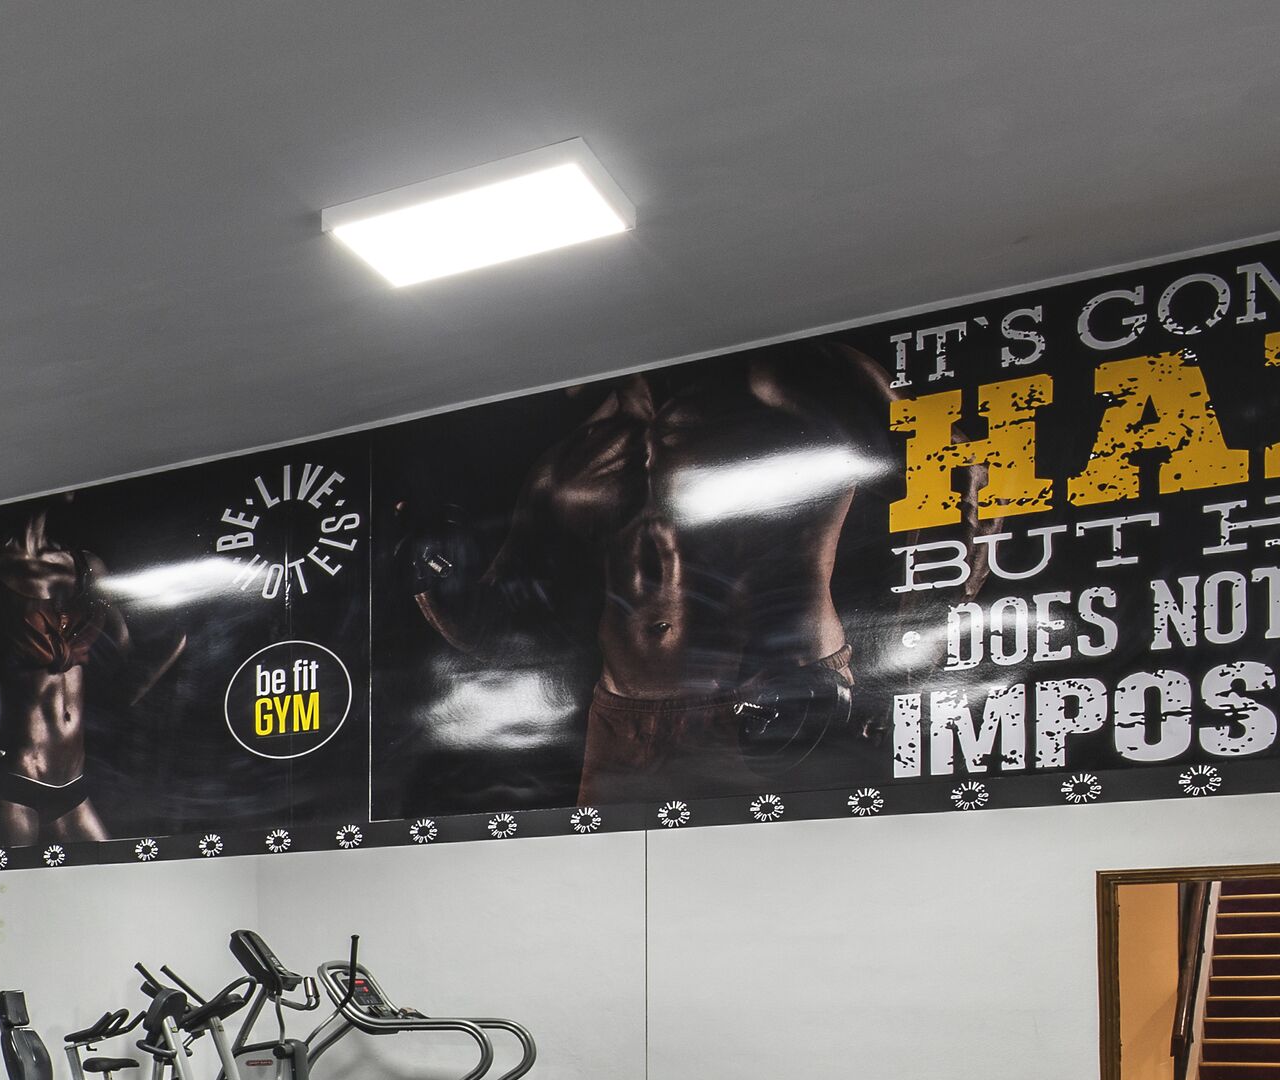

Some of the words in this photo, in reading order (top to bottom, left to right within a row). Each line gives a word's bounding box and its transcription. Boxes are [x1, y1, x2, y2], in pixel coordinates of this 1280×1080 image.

[889, 332, 1280, 532] HA
[254, 463, 346, 509] LIVE
[216, 508, 260, 552] BE
[232, 513, 360, 600] HOTELS
[890, 512, 1159, 594] BUT
[944, 586, 1119, 672] DOES
[1150, 566, 1280, 650] NOT
[256, 664, 286, 697] be
[293, 659, 319, 693] fit
[255, 692, 320, 736] GYM
[892, 660, 1277, 778] IMPOS
[961, 782, 985, 792] LIVE
[1071, 774, 1097, 784] LIVE
[1190, 765, 1217, 776] LIVE
